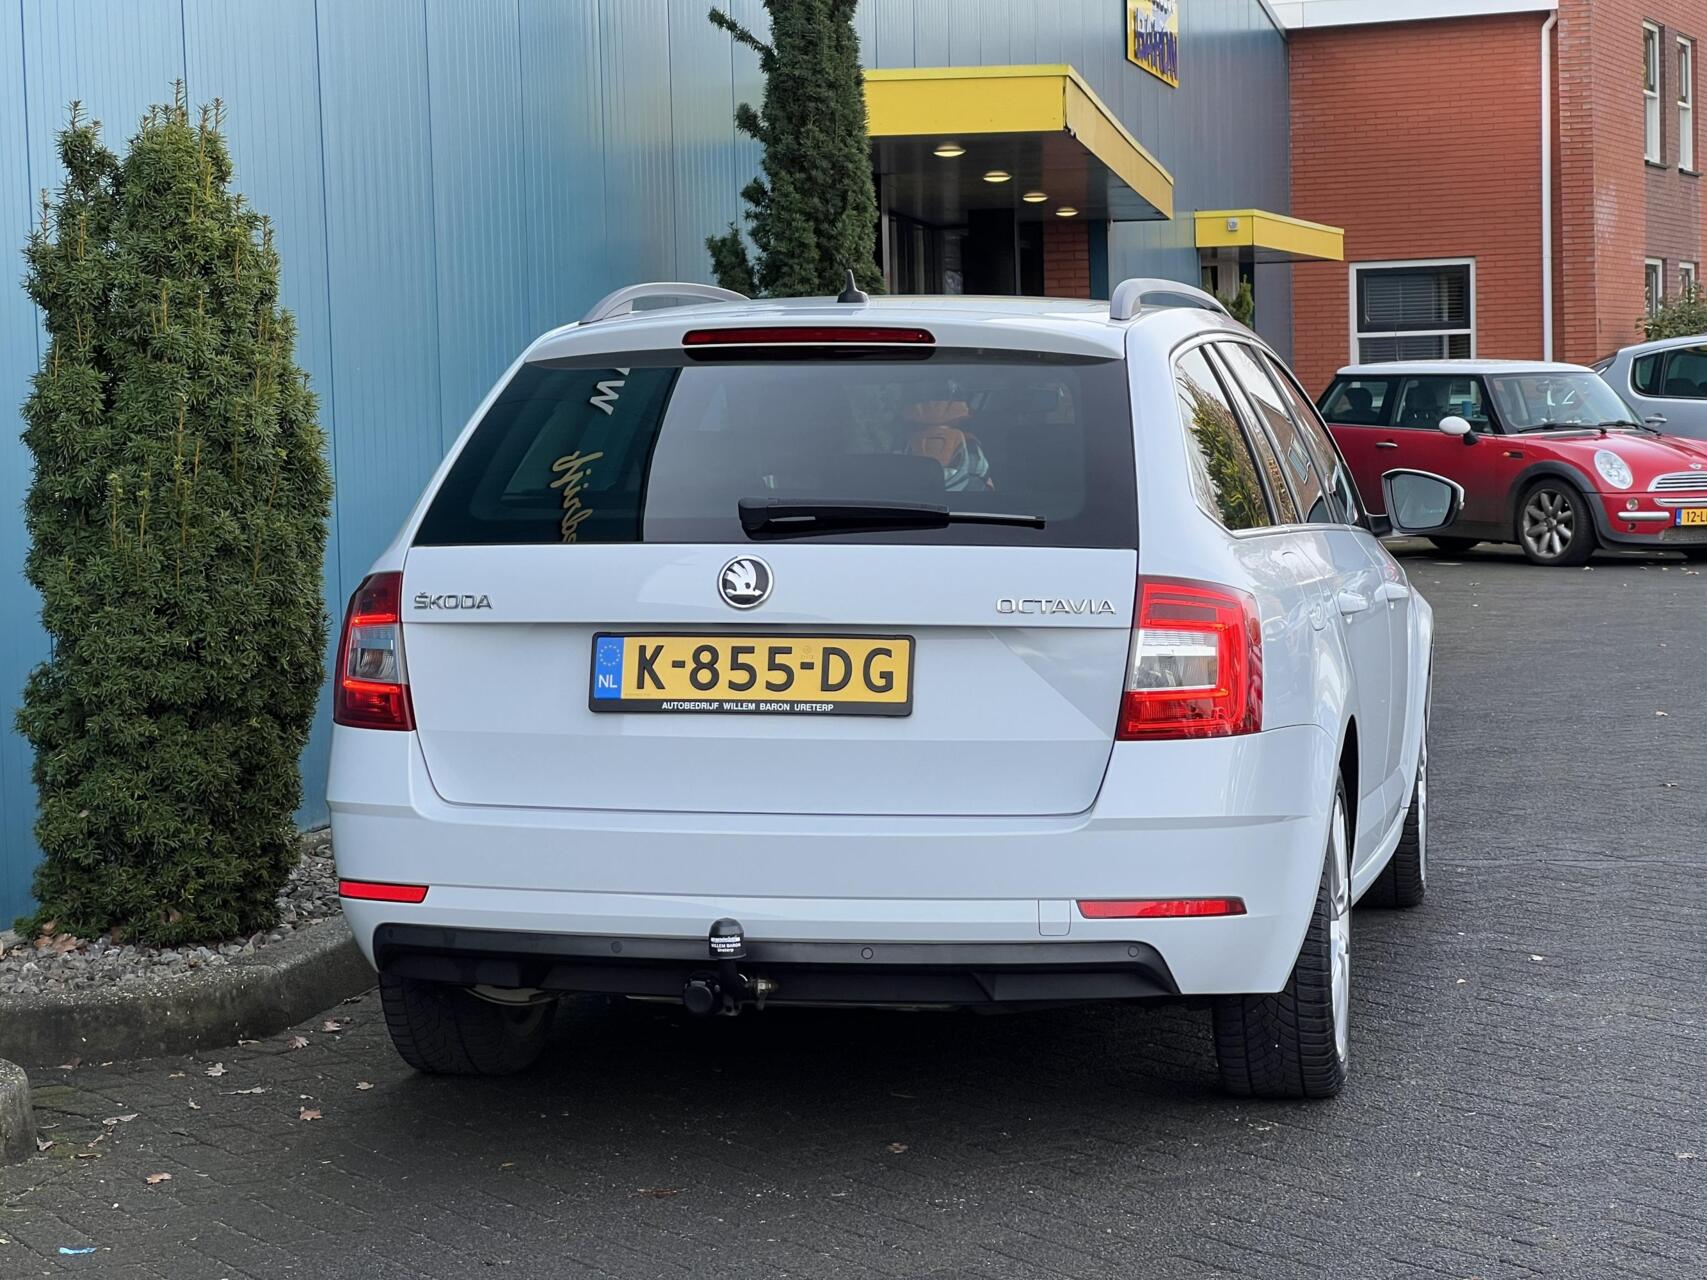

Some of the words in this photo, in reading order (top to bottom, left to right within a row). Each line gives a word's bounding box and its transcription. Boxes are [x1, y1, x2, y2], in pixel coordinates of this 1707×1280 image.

[1686, 510, 1707, 523] 12-L
[414, 592, 493, 610] ŠKODA
[996, 598, 1116, 615] OCTAVIA
[636, 643, 894, 694] K-855-DG
[598, 673, 619, 689] NL
[661, 701, 720, 711] AUTOBEDRIJF
[723, 702, 756, 711] WILLEM
[759, 702, 791, 712] BARON
[794, 703, 835, 712] URETERP
